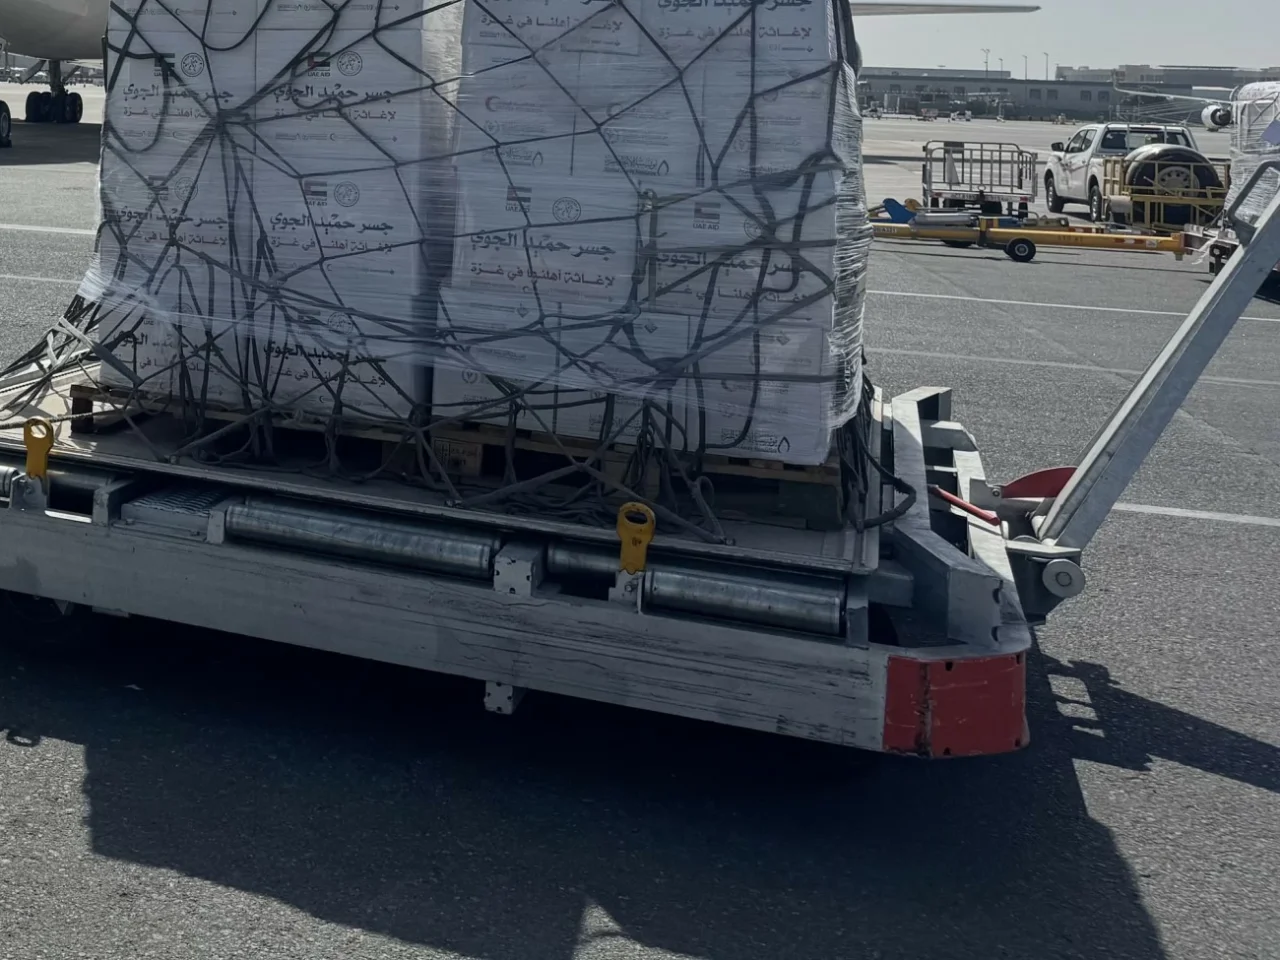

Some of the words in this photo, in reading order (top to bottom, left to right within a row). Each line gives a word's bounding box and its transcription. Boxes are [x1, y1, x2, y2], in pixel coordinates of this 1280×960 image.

[759, 26, 812, 40] لإغاثة
[123, 84, 159, 101] الجوي
[270, 212, 310, 231] الجوي
[571, 245, 616, 261] جسر
[470, 262, 504, 275] غزة
[507, 266, 523, 281] في
[564, 271, 616, 288] لإغاثة
